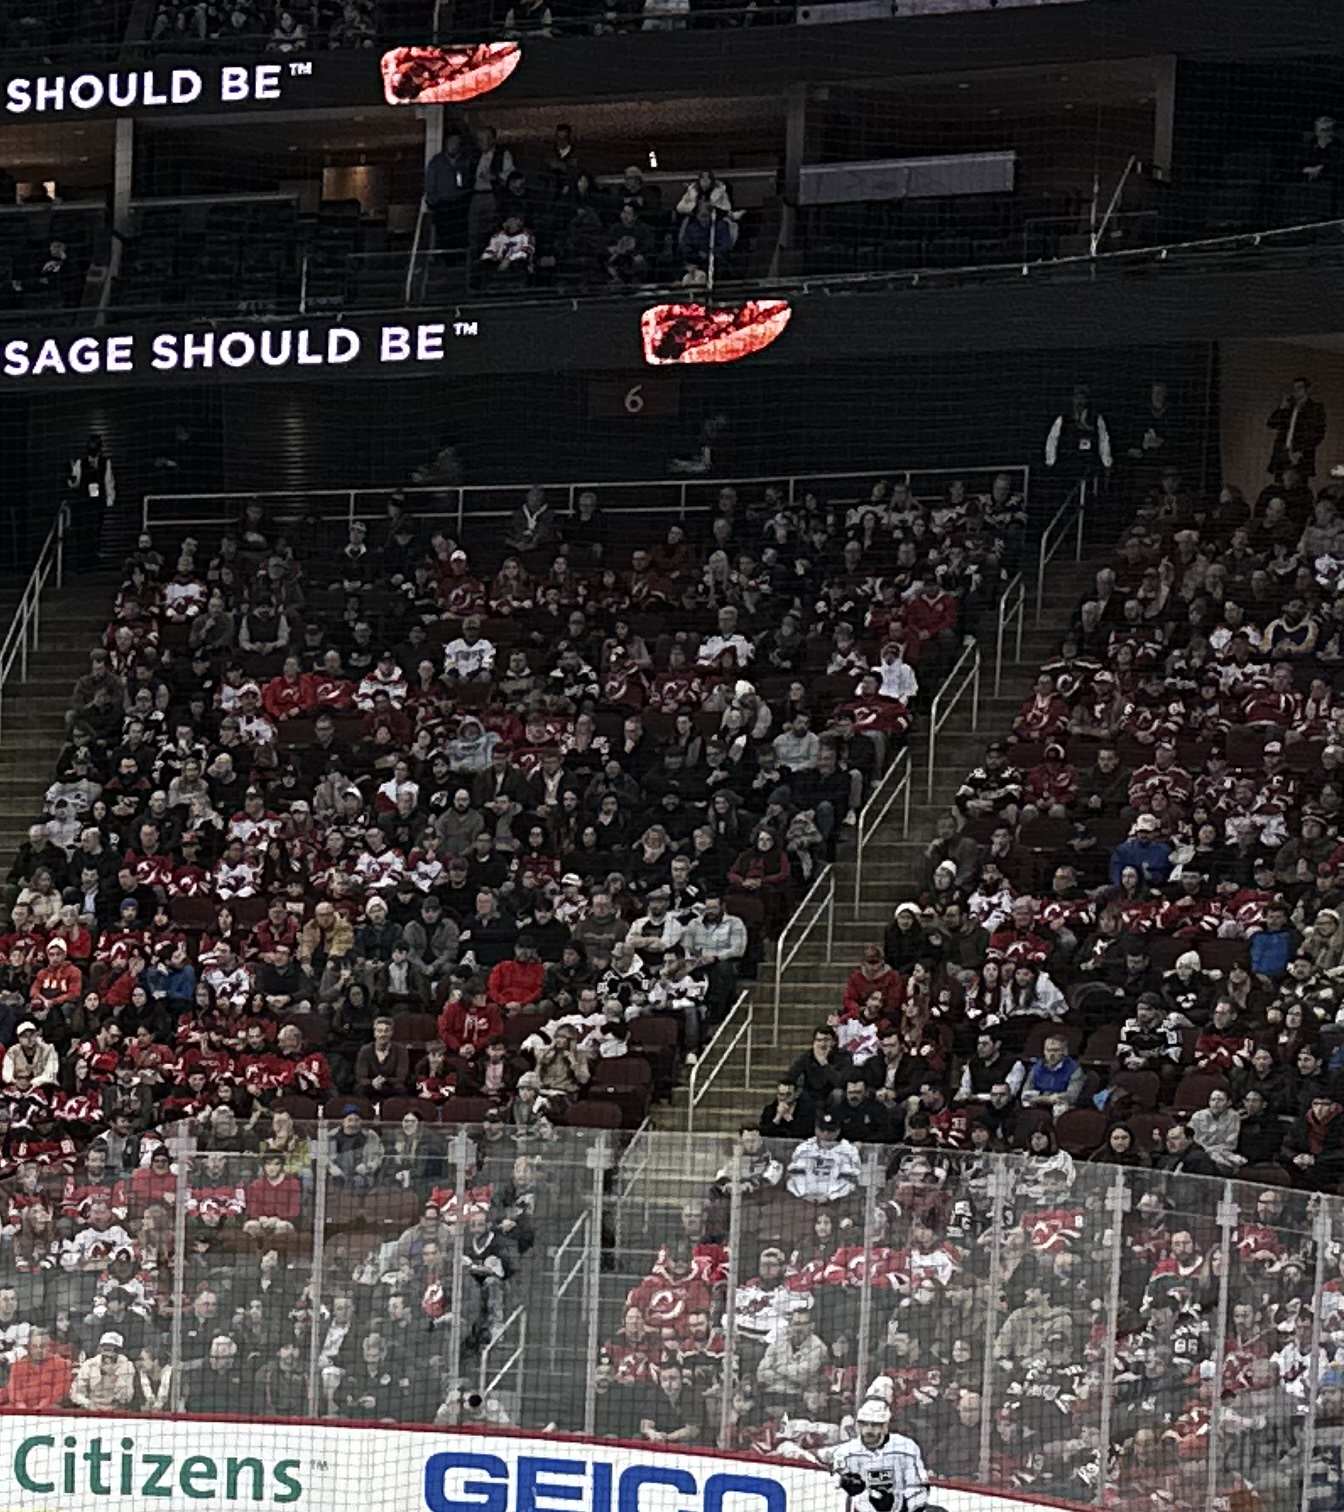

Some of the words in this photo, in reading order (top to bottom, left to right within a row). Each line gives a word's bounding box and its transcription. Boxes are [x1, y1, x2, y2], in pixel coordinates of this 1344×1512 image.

[6, 66, 202, 112] SHOULD
[151, 327, 360, 369] SHOULD
[626, 385, 643, 412] 6
